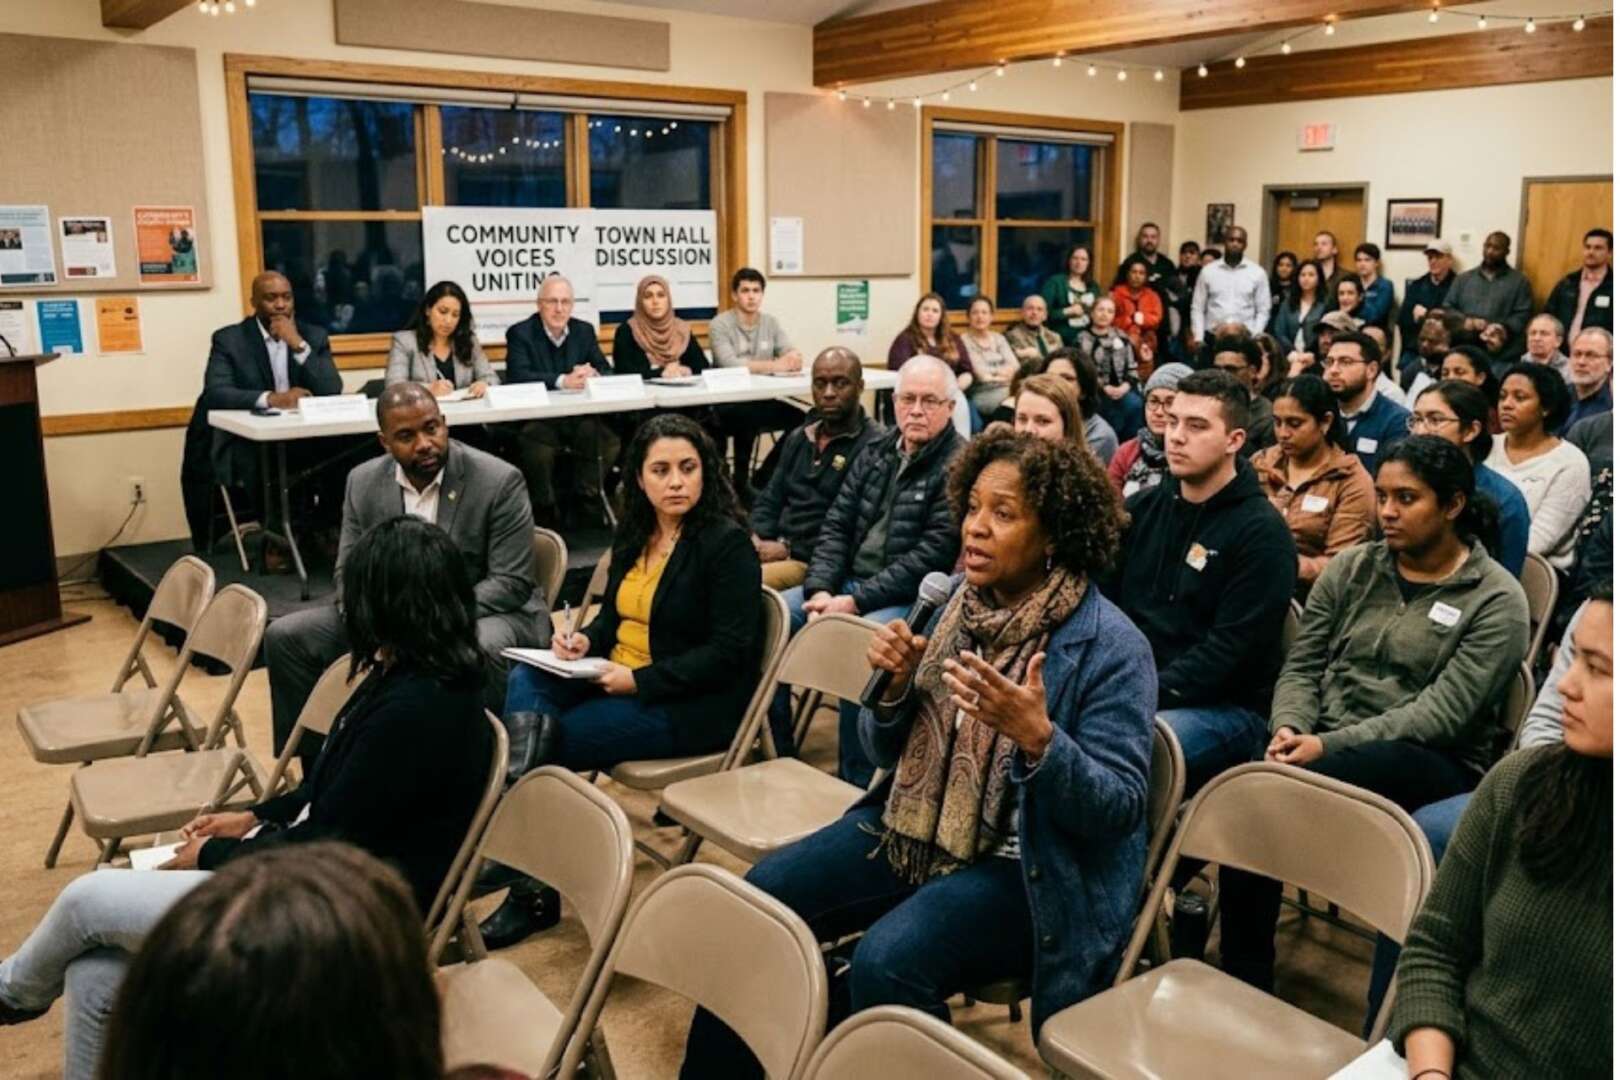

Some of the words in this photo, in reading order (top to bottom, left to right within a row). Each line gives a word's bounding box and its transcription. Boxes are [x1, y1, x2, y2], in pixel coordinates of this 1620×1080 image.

[446, 224, 580, 244] COMMUNITY
[595, 226, 656, 245] TOWN
[662, 226, 710, 244] HALL
[475, 248, 556, 267] VOICES
[595, 248, 711, 267] DISCUSSION
[472, 271, 560, 292] UNITIN
